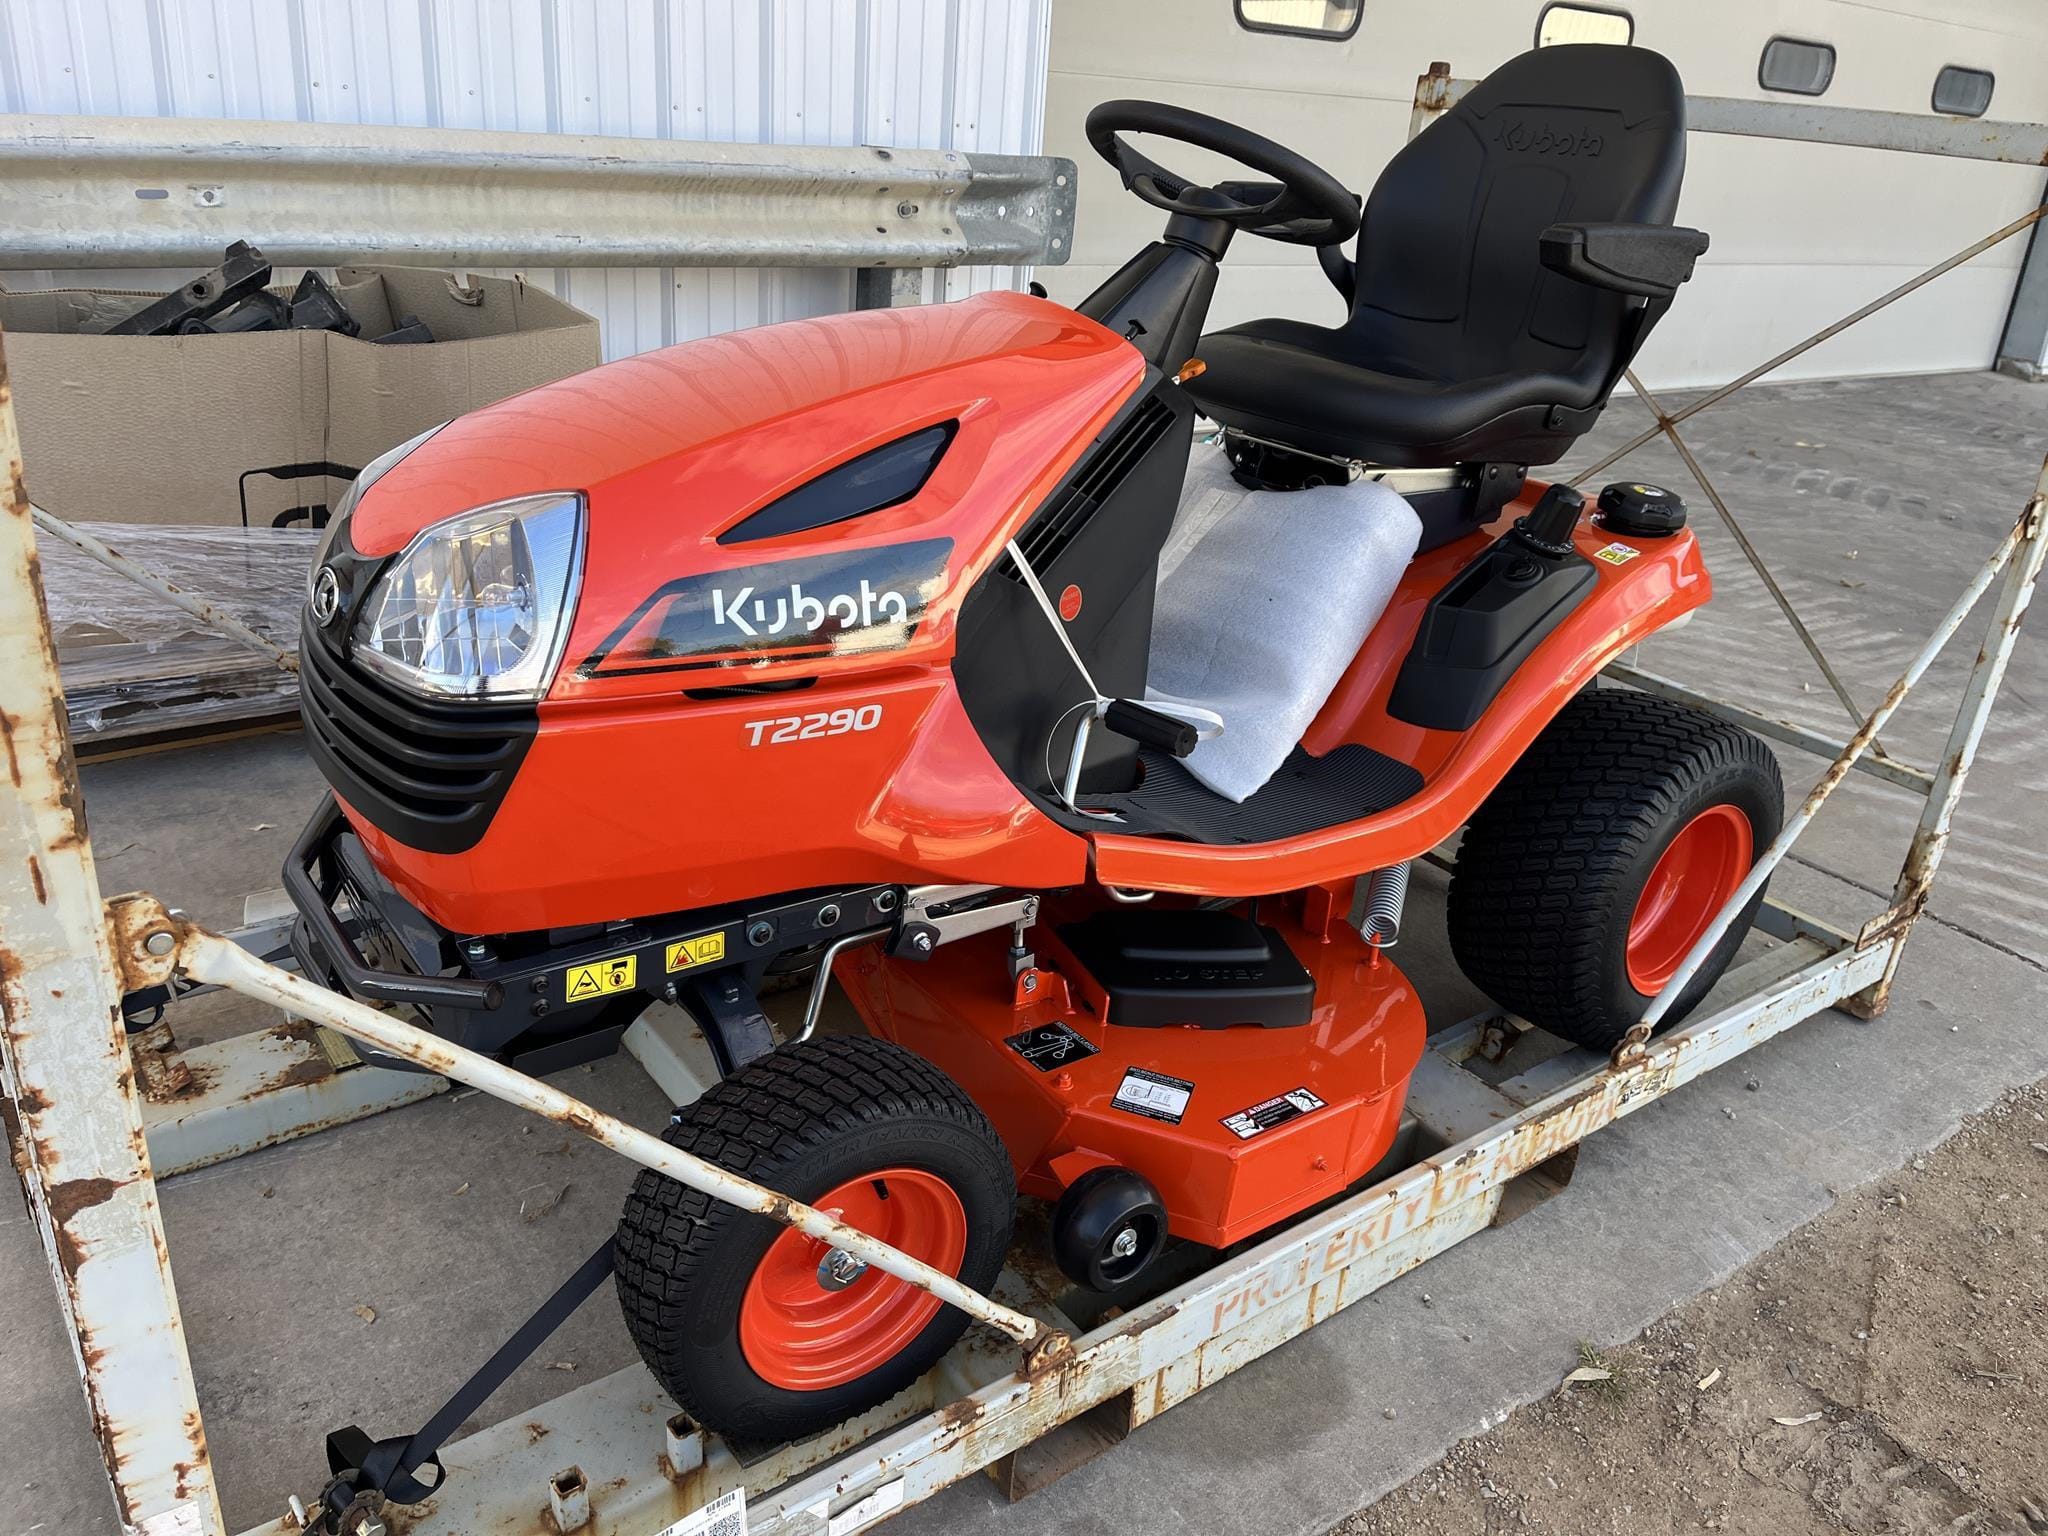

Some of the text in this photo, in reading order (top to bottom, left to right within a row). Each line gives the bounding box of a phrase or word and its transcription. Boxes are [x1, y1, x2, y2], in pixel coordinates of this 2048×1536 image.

[1493, 119, 1605, 158] Kubota
[712, 579, 907, 636] Kubota
[744, 704, 883, 747] T2290
[1199, 967, 1264, 982] STEP
[1255, 1097, 1284, 1113] DANGER
